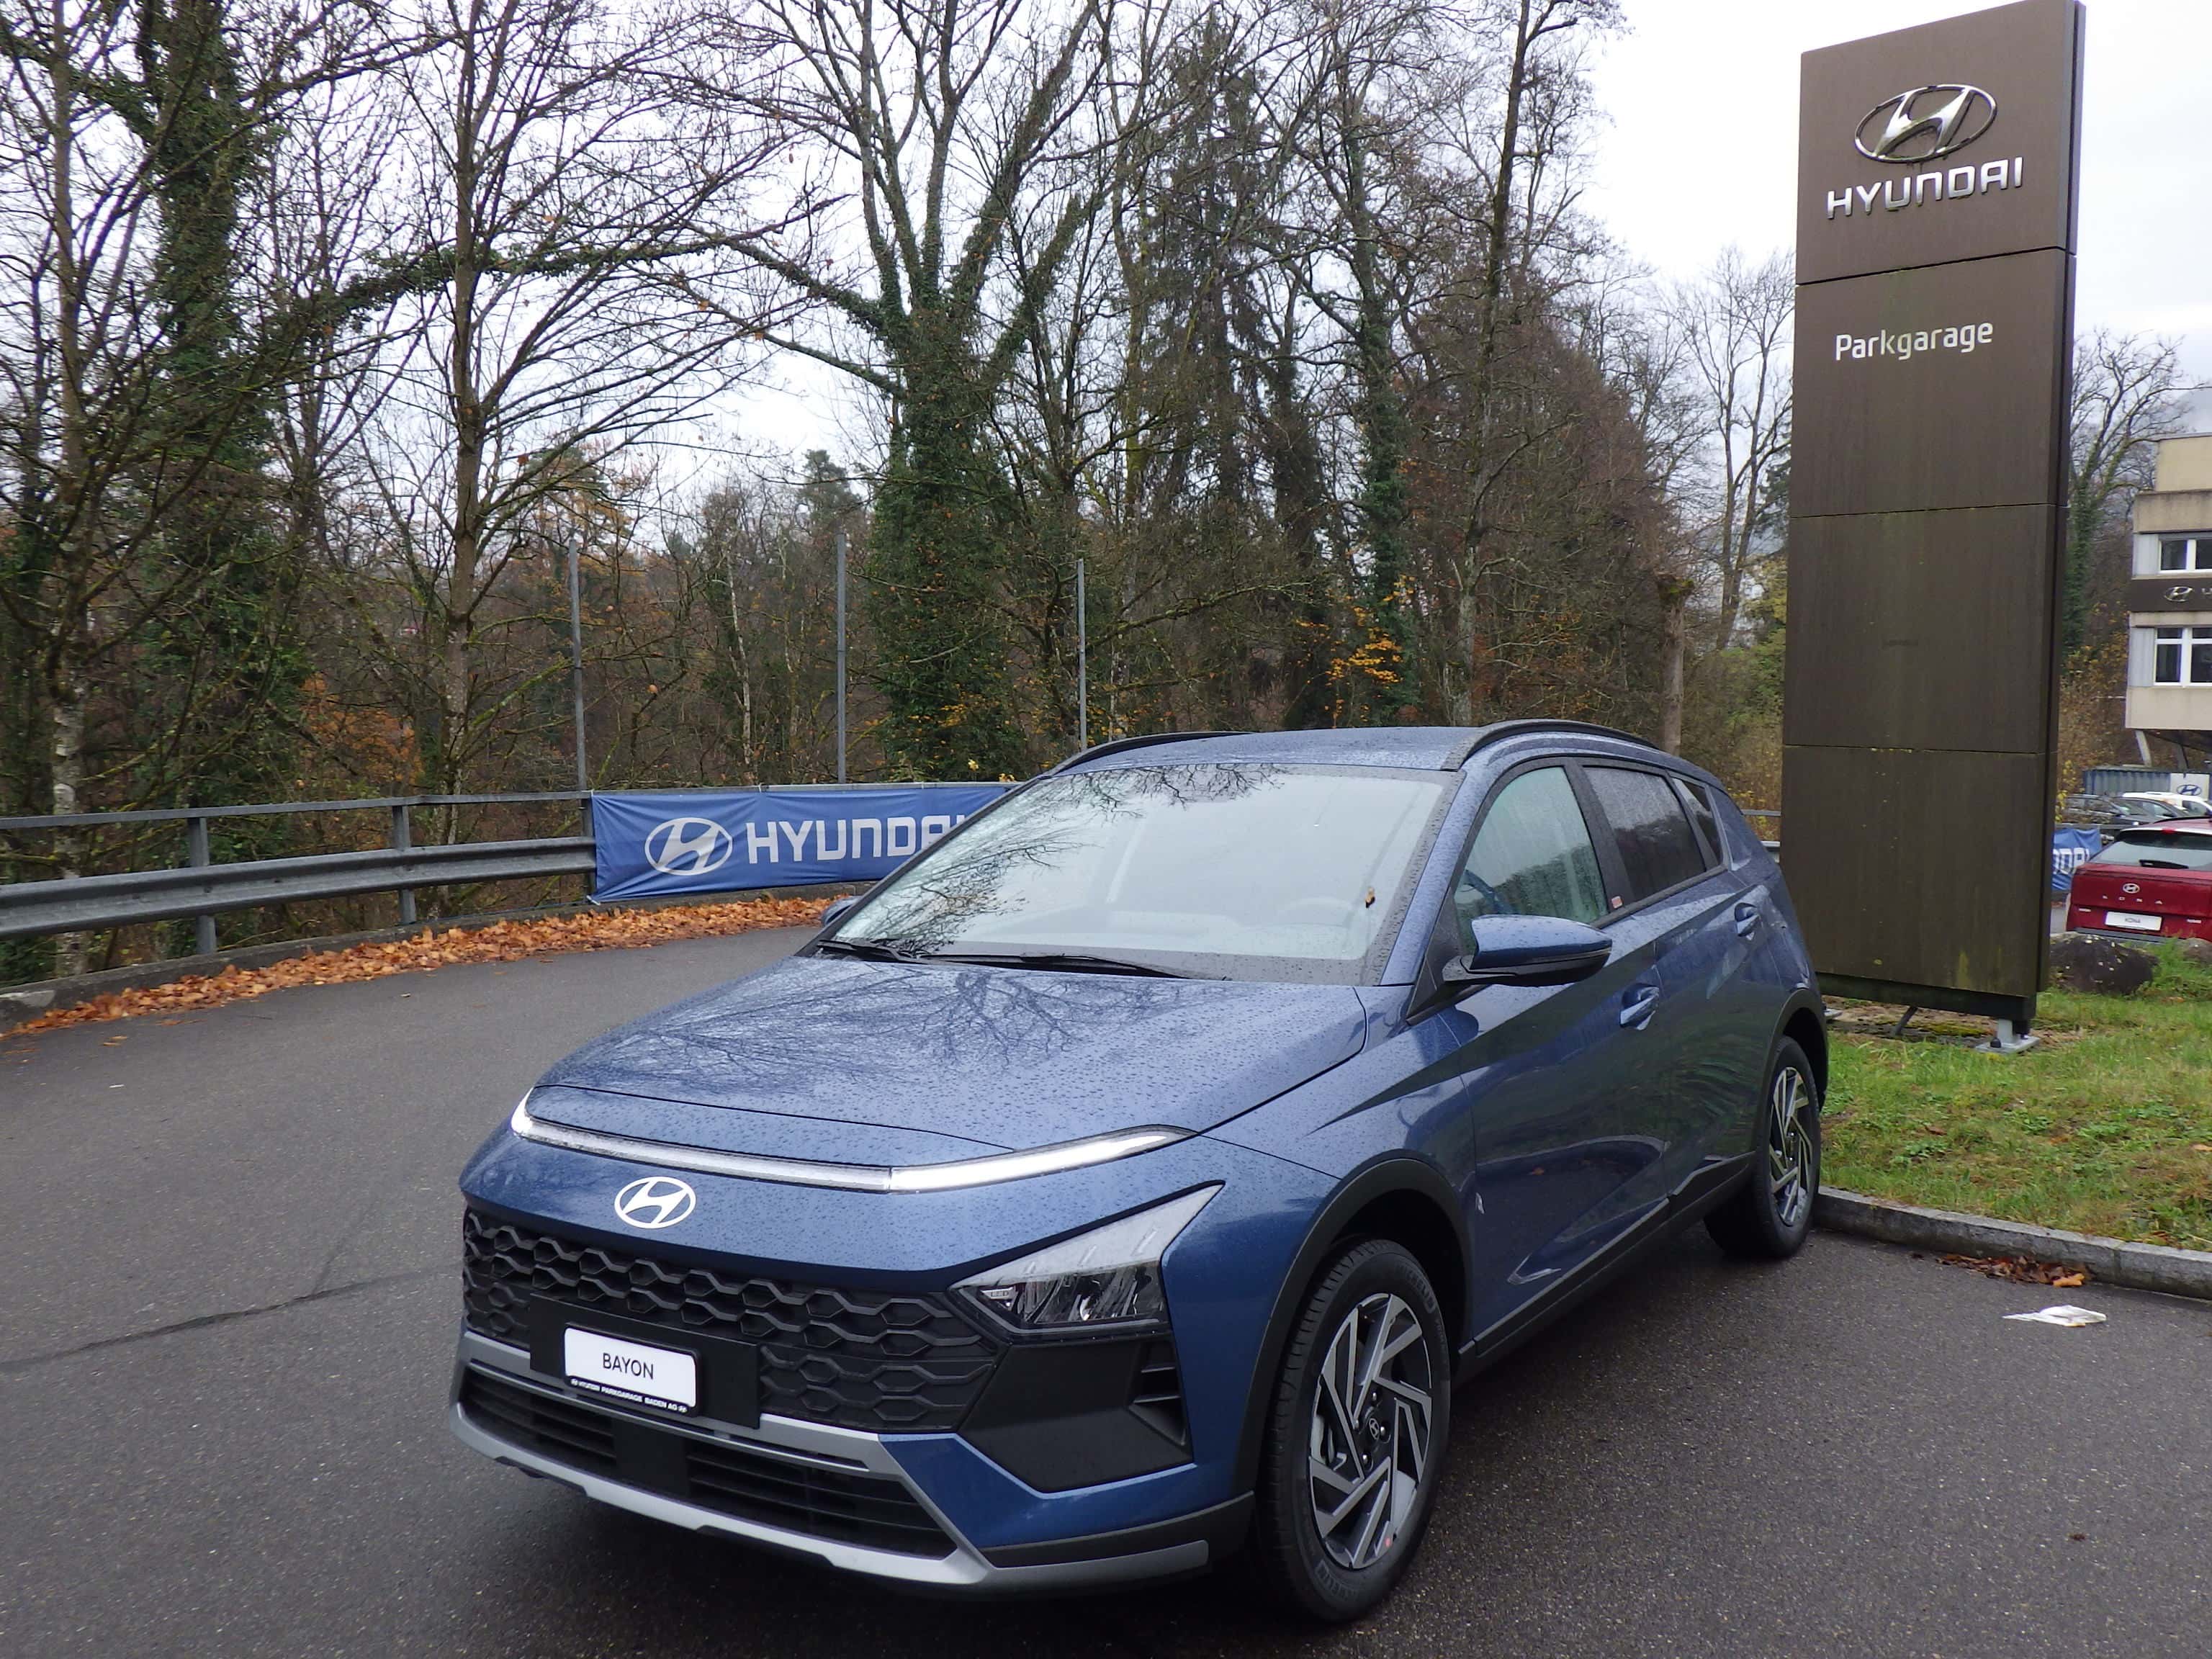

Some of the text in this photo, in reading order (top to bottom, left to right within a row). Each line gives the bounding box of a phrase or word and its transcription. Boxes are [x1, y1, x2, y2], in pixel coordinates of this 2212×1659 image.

[1827, 156, 2023, 220] HYUNDAI
[1835, 321, 1994, 361] Parkgarage
[746, 814, 965, 863] HYUNDA
[603, 1352, 654, 1380] BAYON
